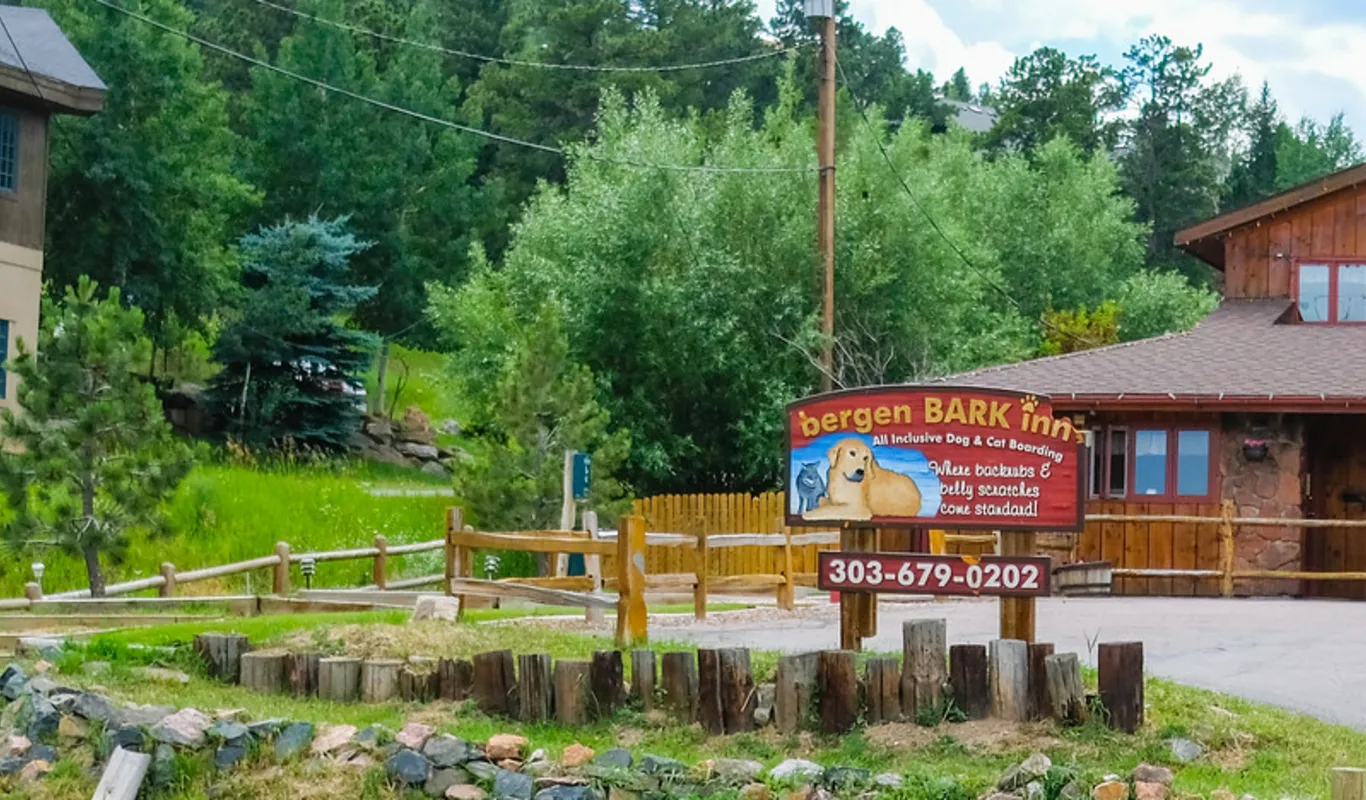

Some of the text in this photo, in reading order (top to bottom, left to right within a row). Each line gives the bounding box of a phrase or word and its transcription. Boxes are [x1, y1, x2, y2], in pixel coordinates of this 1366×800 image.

[800, 397, 1072, 443] bergen BARK inn
[873, 433, 1063, 463] All Inclusive Dog & Cat Boarding
[929, 460, 971, 477] Where
[975, 462, 1035, 478] backrubs
[940, 480, 1040, 500] belly scratches
[975, 500, 1038, 517] standard!
[829, 559, 1039, 589] 303-679-0202
